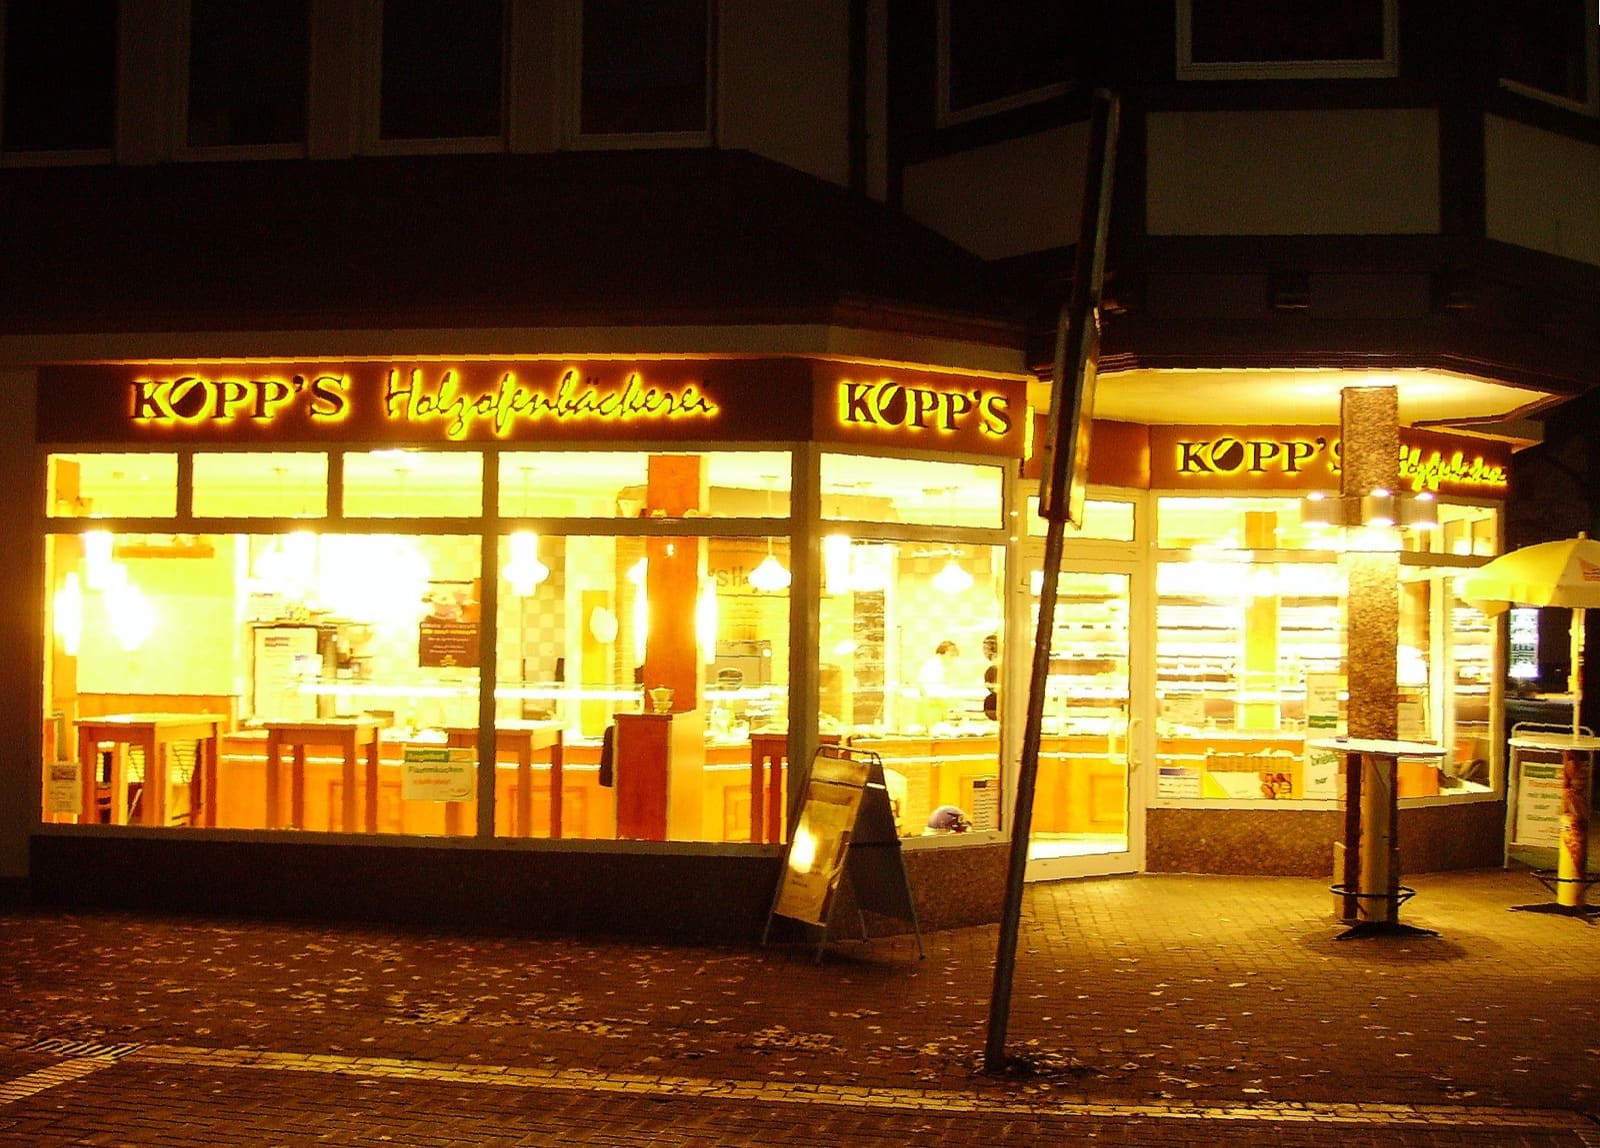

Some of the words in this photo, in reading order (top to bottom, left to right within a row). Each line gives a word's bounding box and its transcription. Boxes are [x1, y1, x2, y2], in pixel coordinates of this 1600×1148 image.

[131, 374, 347, 420] KOPP'S
[841, 380, 1013, 436] KOPP'S
[1176, 437, 1341, 474] KOPP'
